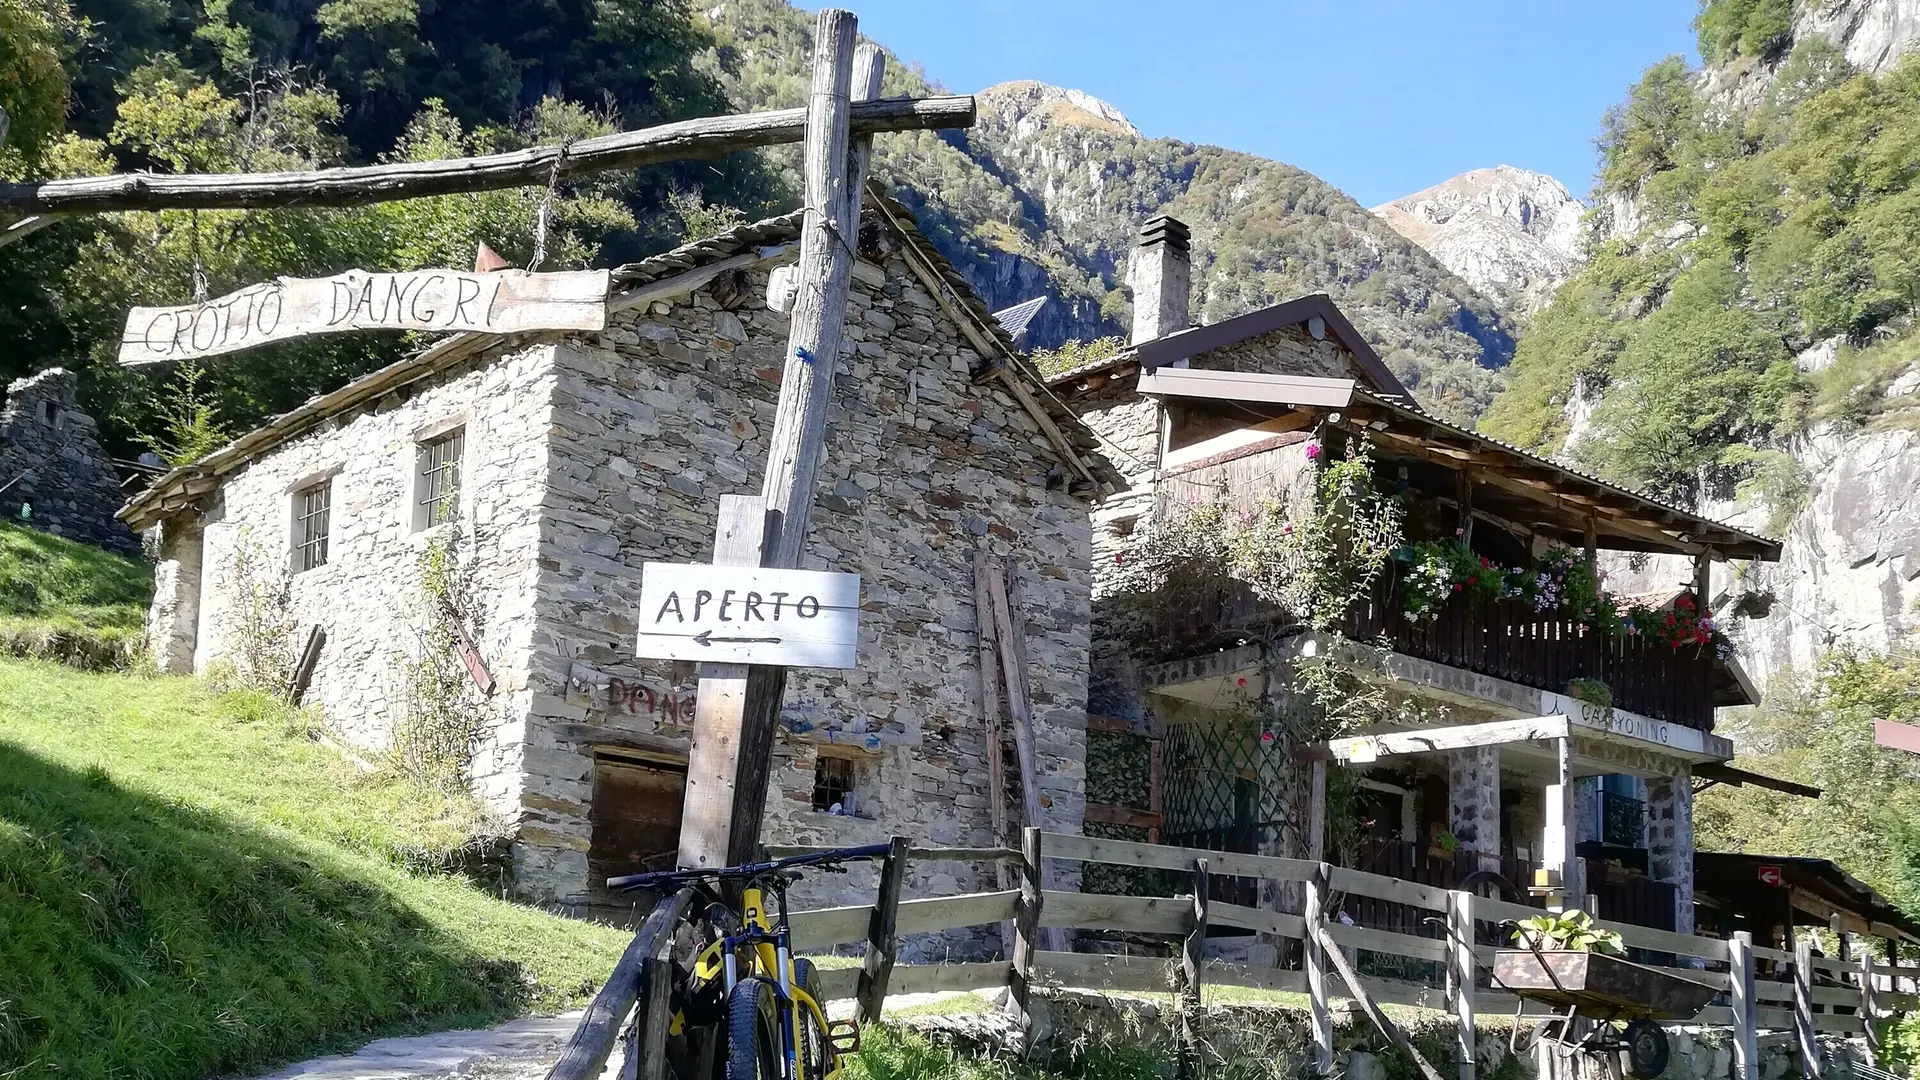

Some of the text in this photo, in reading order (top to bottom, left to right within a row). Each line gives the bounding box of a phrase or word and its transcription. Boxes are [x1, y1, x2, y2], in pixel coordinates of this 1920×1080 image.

[145, 285, 282, 356] CROTTO
[655, 589, 819, 624] APERTO
[1581, 703, 1669, 743] CAYONING
